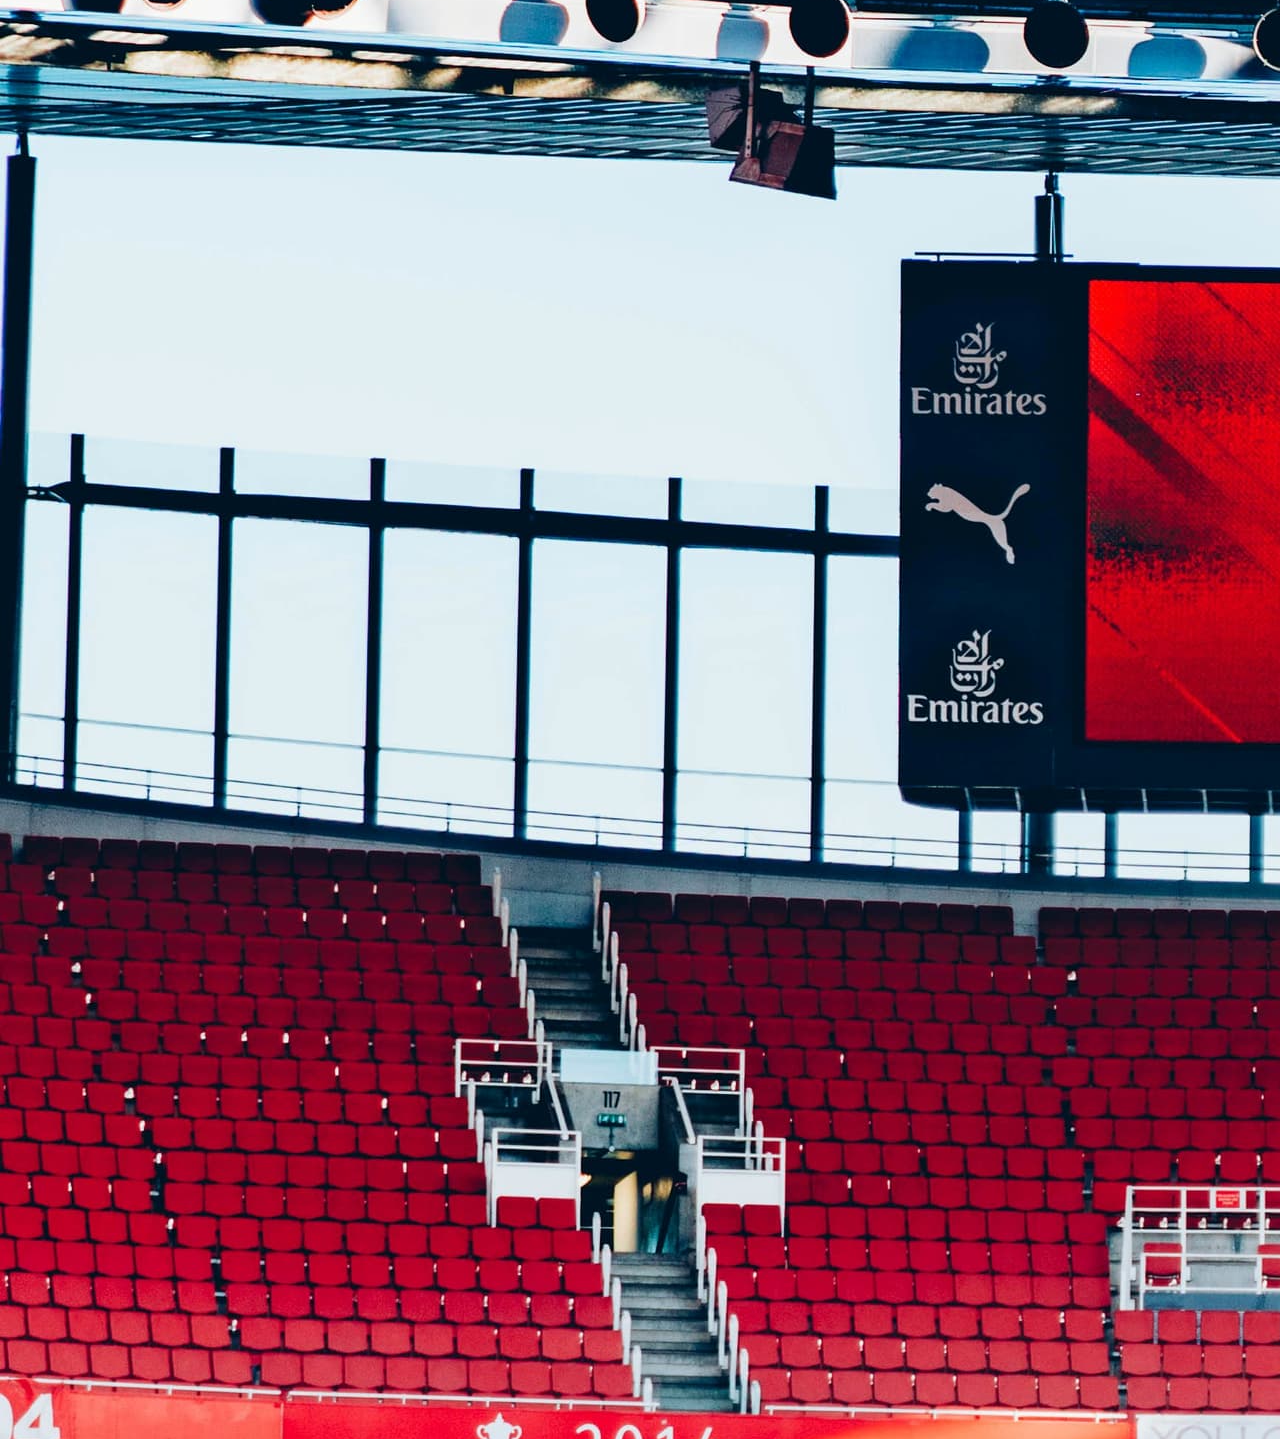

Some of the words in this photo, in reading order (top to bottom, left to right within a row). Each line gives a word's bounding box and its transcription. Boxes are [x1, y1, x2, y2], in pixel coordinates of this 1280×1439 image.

[911, 387, 1048, 416] Emirates
[906, 694, 1044, 725] Emirates
[602, 1090, 621, 1108] 117
